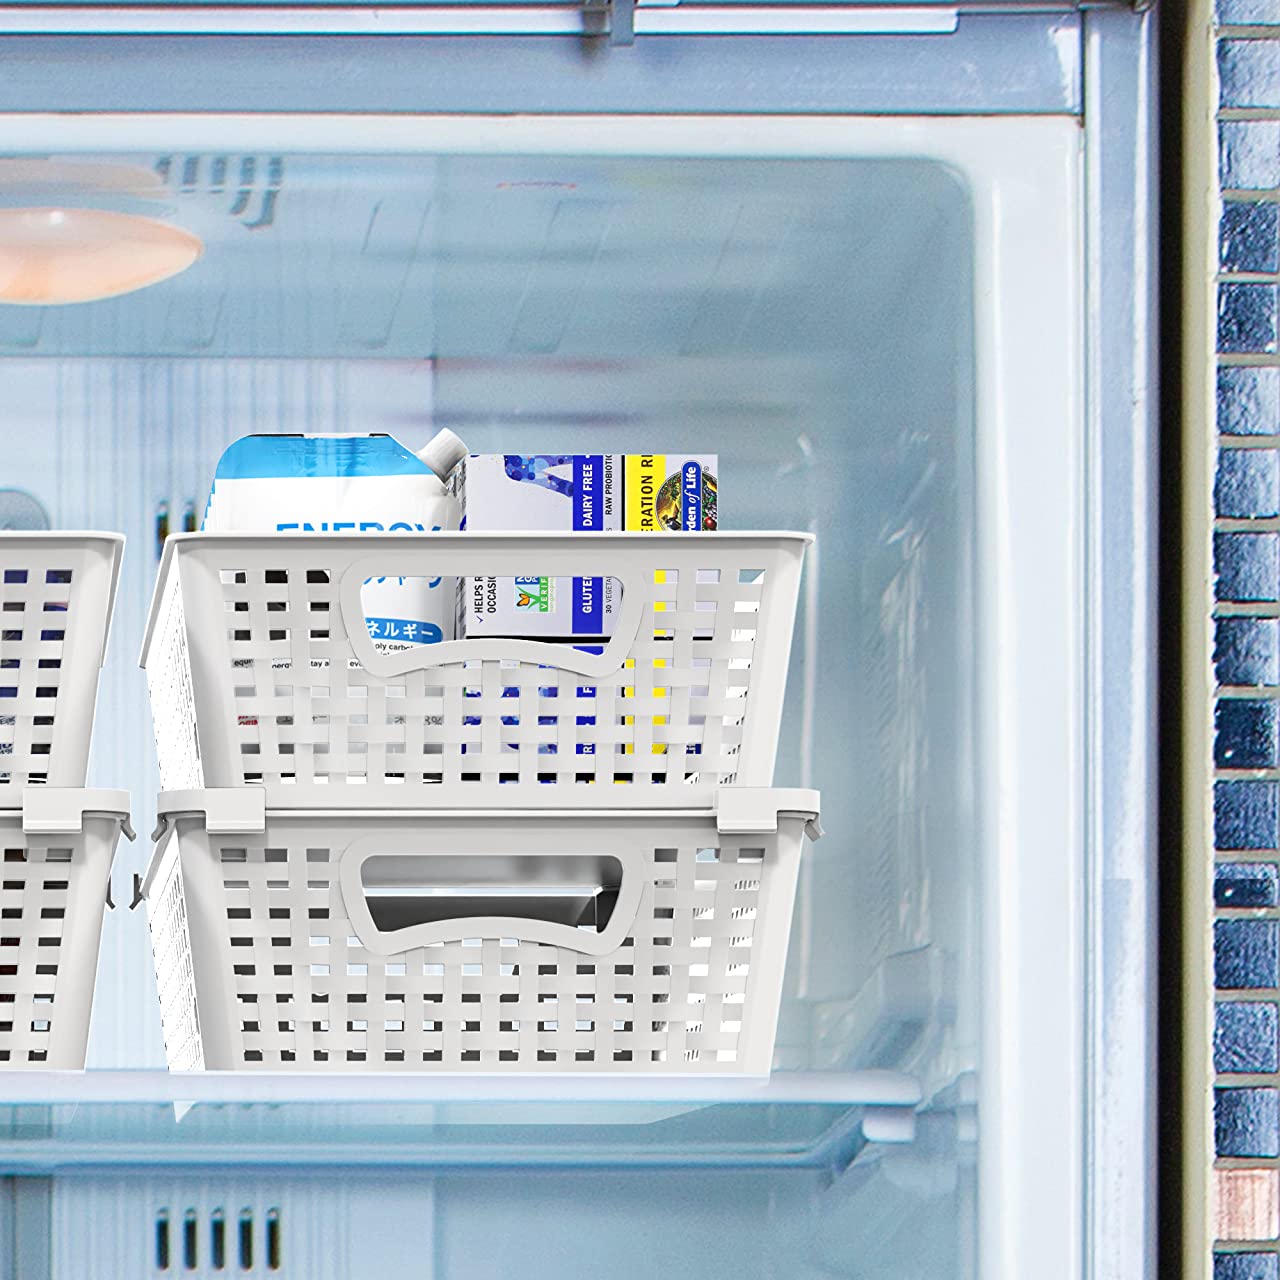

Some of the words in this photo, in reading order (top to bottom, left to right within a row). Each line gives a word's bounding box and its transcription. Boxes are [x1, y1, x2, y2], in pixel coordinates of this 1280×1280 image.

[583, 463, 593, 491] FREE
[687, 466, 696, 488] Life
[605, 497, 613, 516] RAW
[688, 489, 700, 503] of
[583, 494, 593, 526] DAIRY
[474, 585, 484, 614] HELPS
[605, 604, 613, 614] 30
